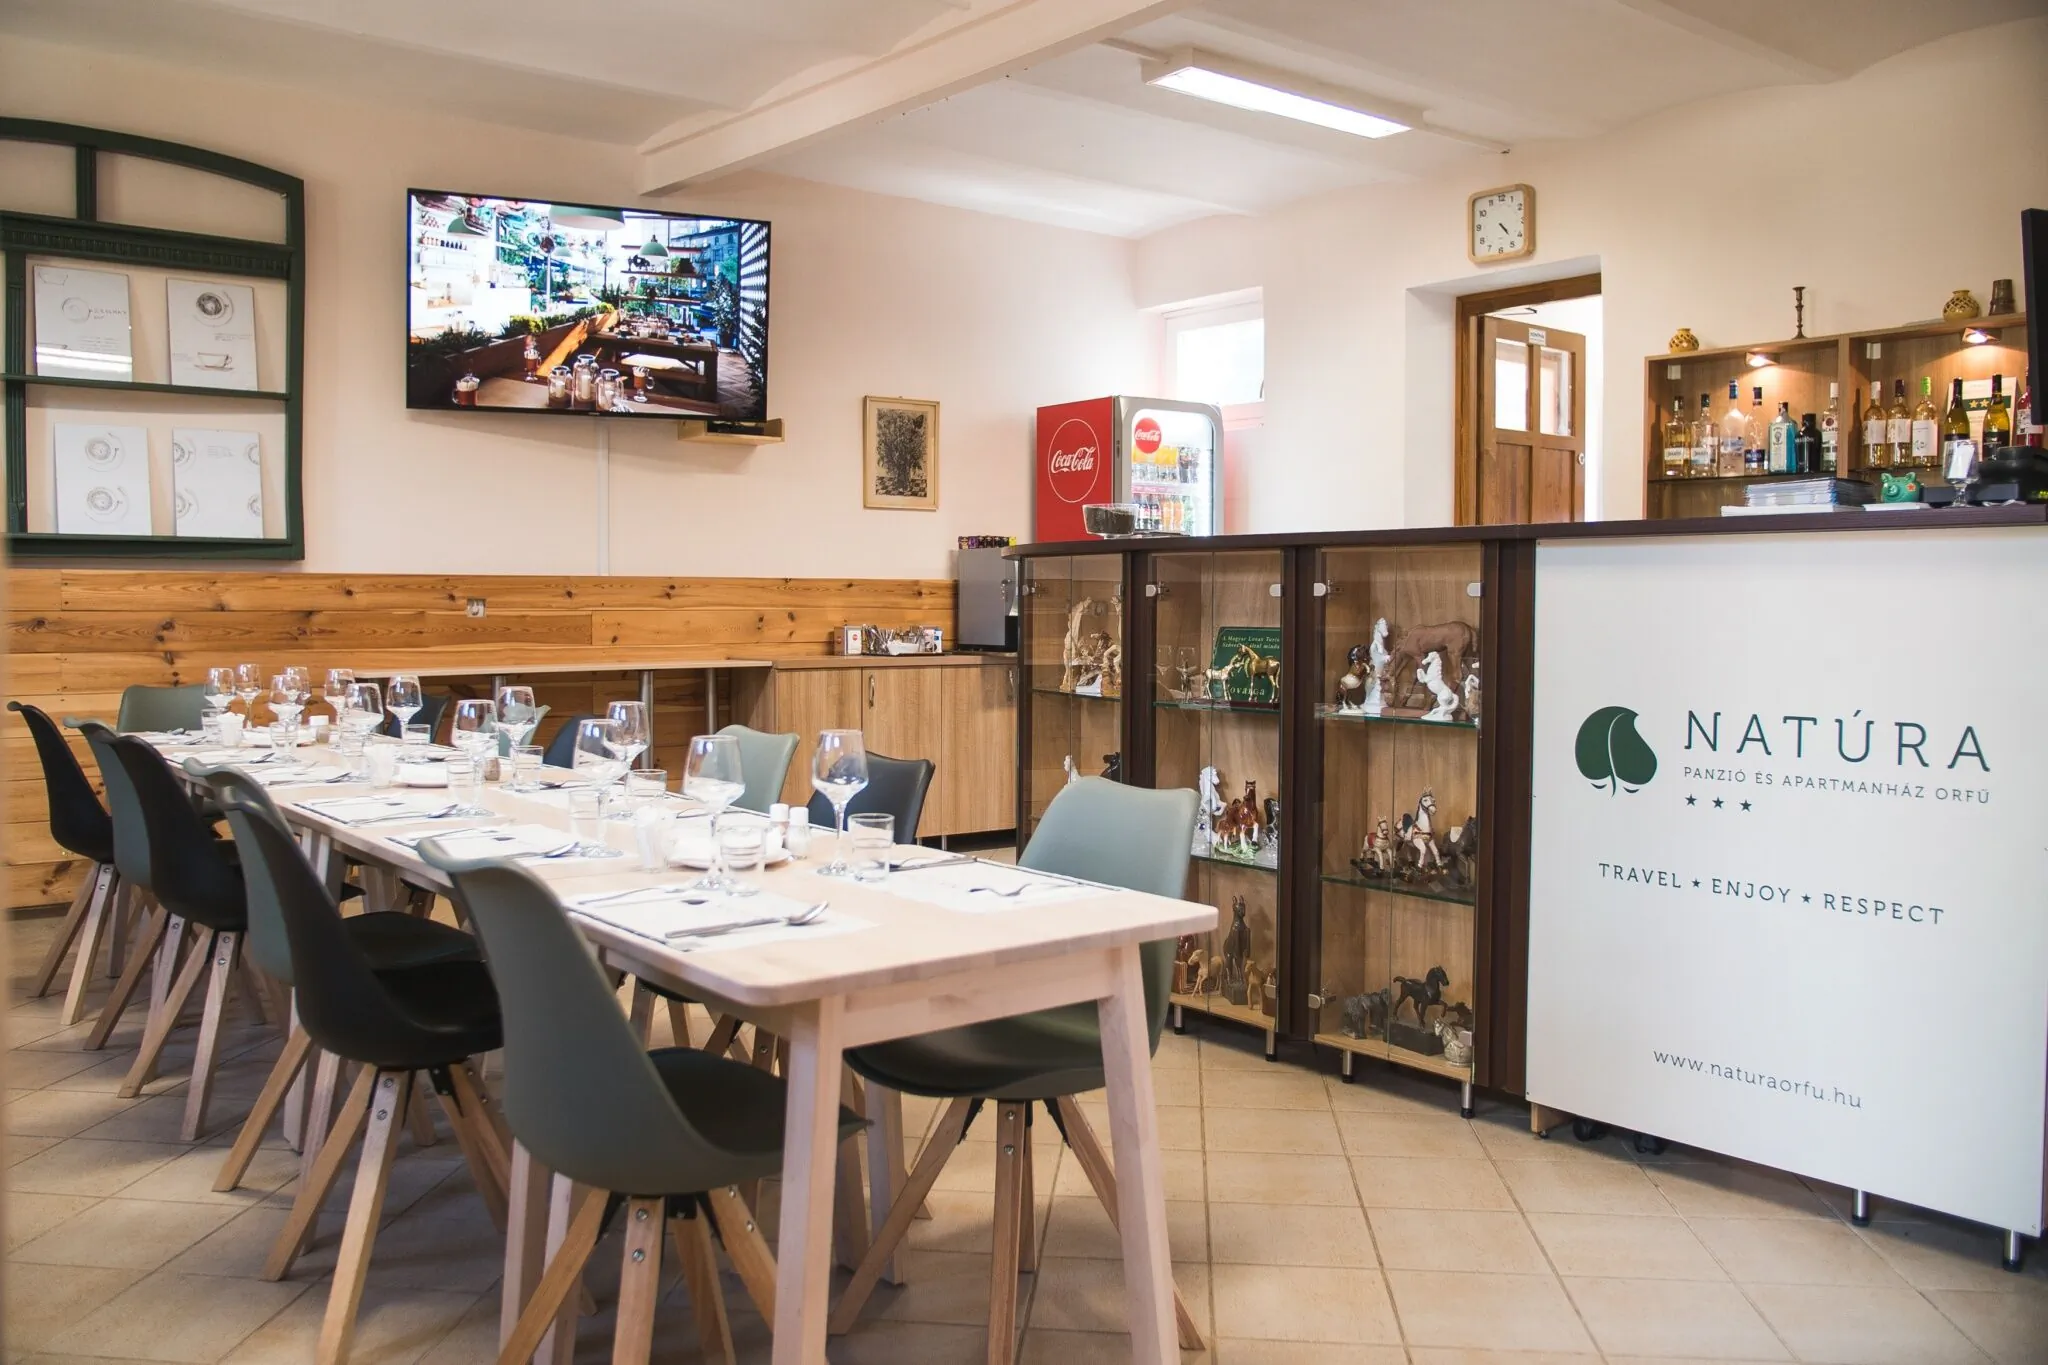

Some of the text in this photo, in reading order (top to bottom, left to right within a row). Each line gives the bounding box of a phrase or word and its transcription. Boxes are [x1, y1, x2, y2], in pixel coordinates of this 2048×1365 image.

[1498, 194, 1506, 202] 12
[1517, 202, 1522, 211] 2
[1479, 209, 1487, 218] 10
[1476, 224, 1482, 232] 9
[1480, 237, 1485, 245] 8
[1509, 240, 1515, 248] 5
[1498, 246, 1504, 254] 6
[1051, 446, 1096, 474] Coca-Cola
[1684, 709, 1991, 773] NATÚRA
[1683, 766, 1747, 784] PANZIÓ
[1755, 771, 1773, 786] ÉS
[1782, 775, 1925, 800] APARTMANHÁZ
[1598, 862, 1945, 925] TRAVEL ENJOY RESPECT
[1653, 1050, 1863, 1110] www.naturaorfu.hu
